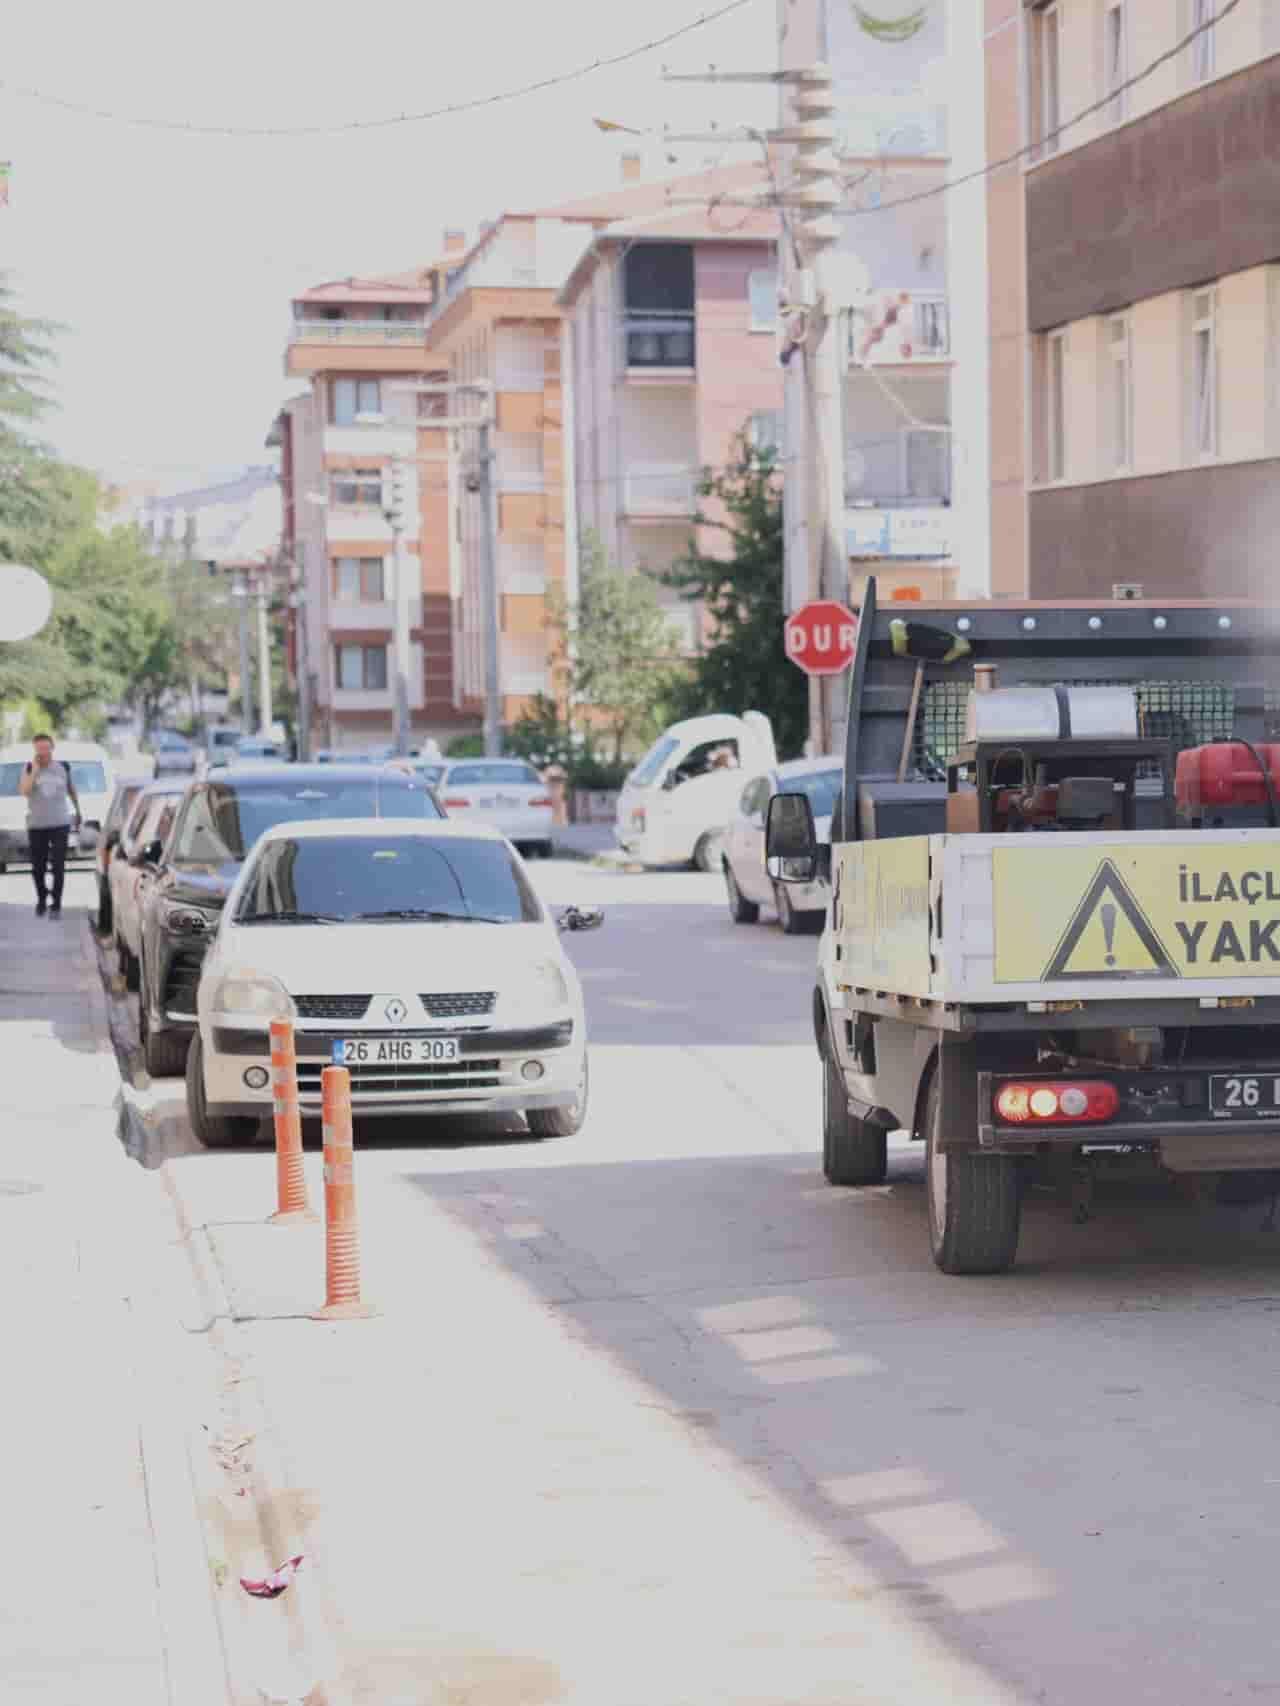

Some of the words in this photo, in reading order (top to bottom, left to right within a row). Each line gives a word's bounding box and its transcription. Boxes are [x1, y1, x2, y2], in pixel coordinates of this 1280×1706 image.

[791, 623, 857, 654] DUR
[344, 1040, 369, 1061] 26
[377, 1041, 413, 1061] AHG
[421, 1040, 456, 1060] 303
[1224, 1078, 1260, 1108] 26
